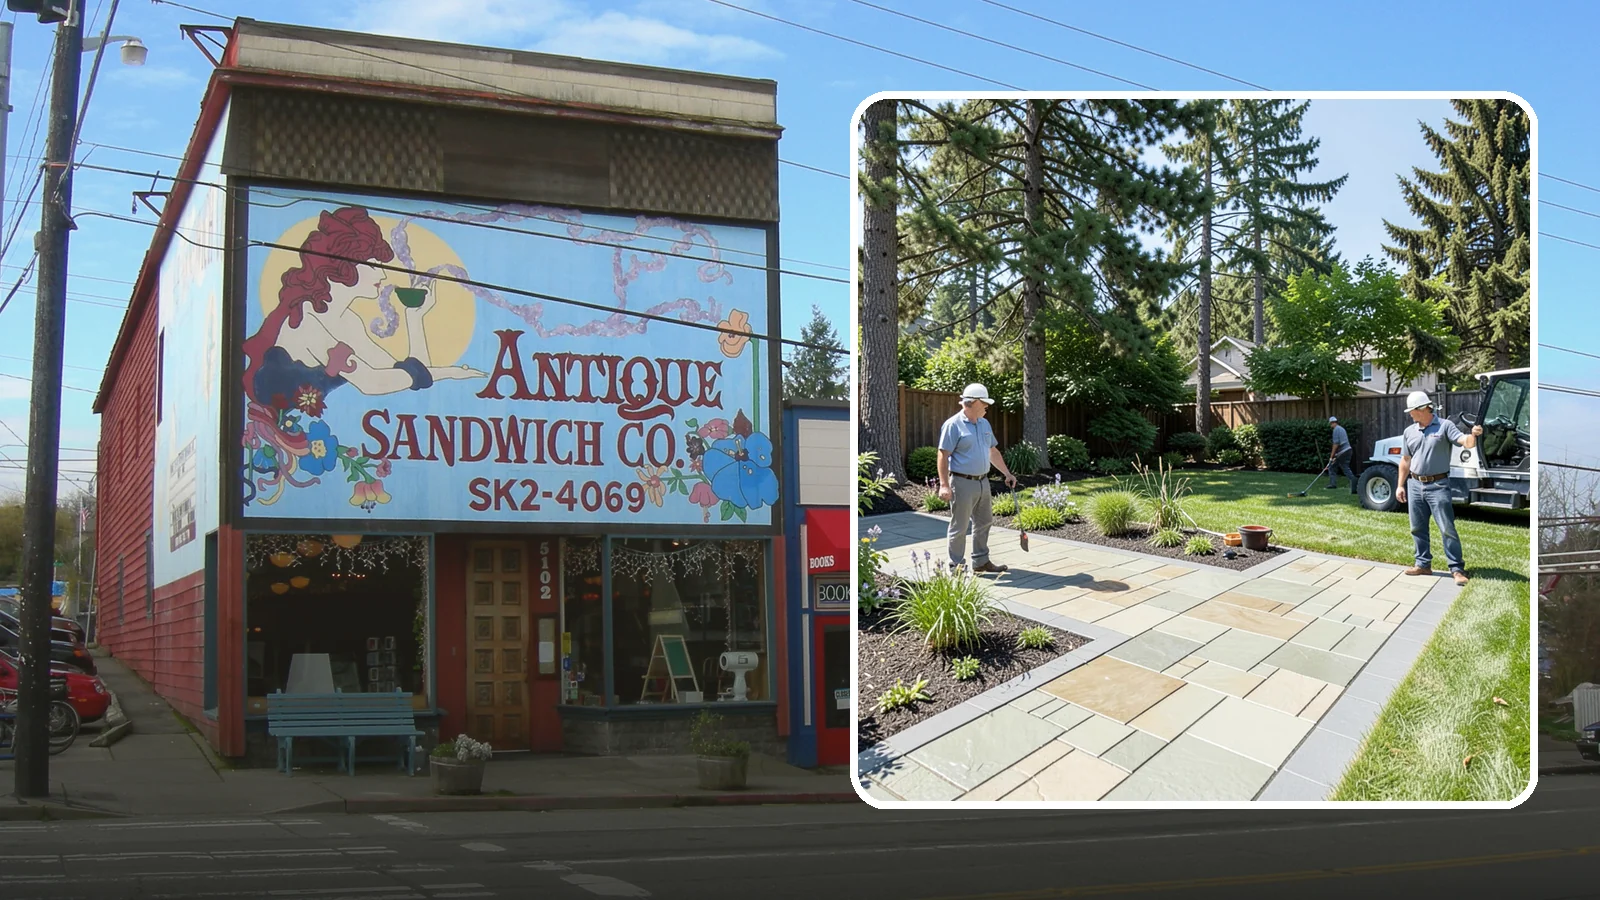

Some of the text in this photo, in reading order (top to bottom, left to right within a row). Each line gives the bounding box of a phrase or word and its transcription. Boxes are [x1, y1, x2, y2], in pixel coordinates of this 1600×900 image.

[476, 329, 722, 420] ANTIQUE
[361, 408, 685, 468] SANDWICH CO.
[468, 477, 645, 513] SK2-4069
[540, 541, 552, 599] 5102
[809, 555, 835, 569] BOOKS
